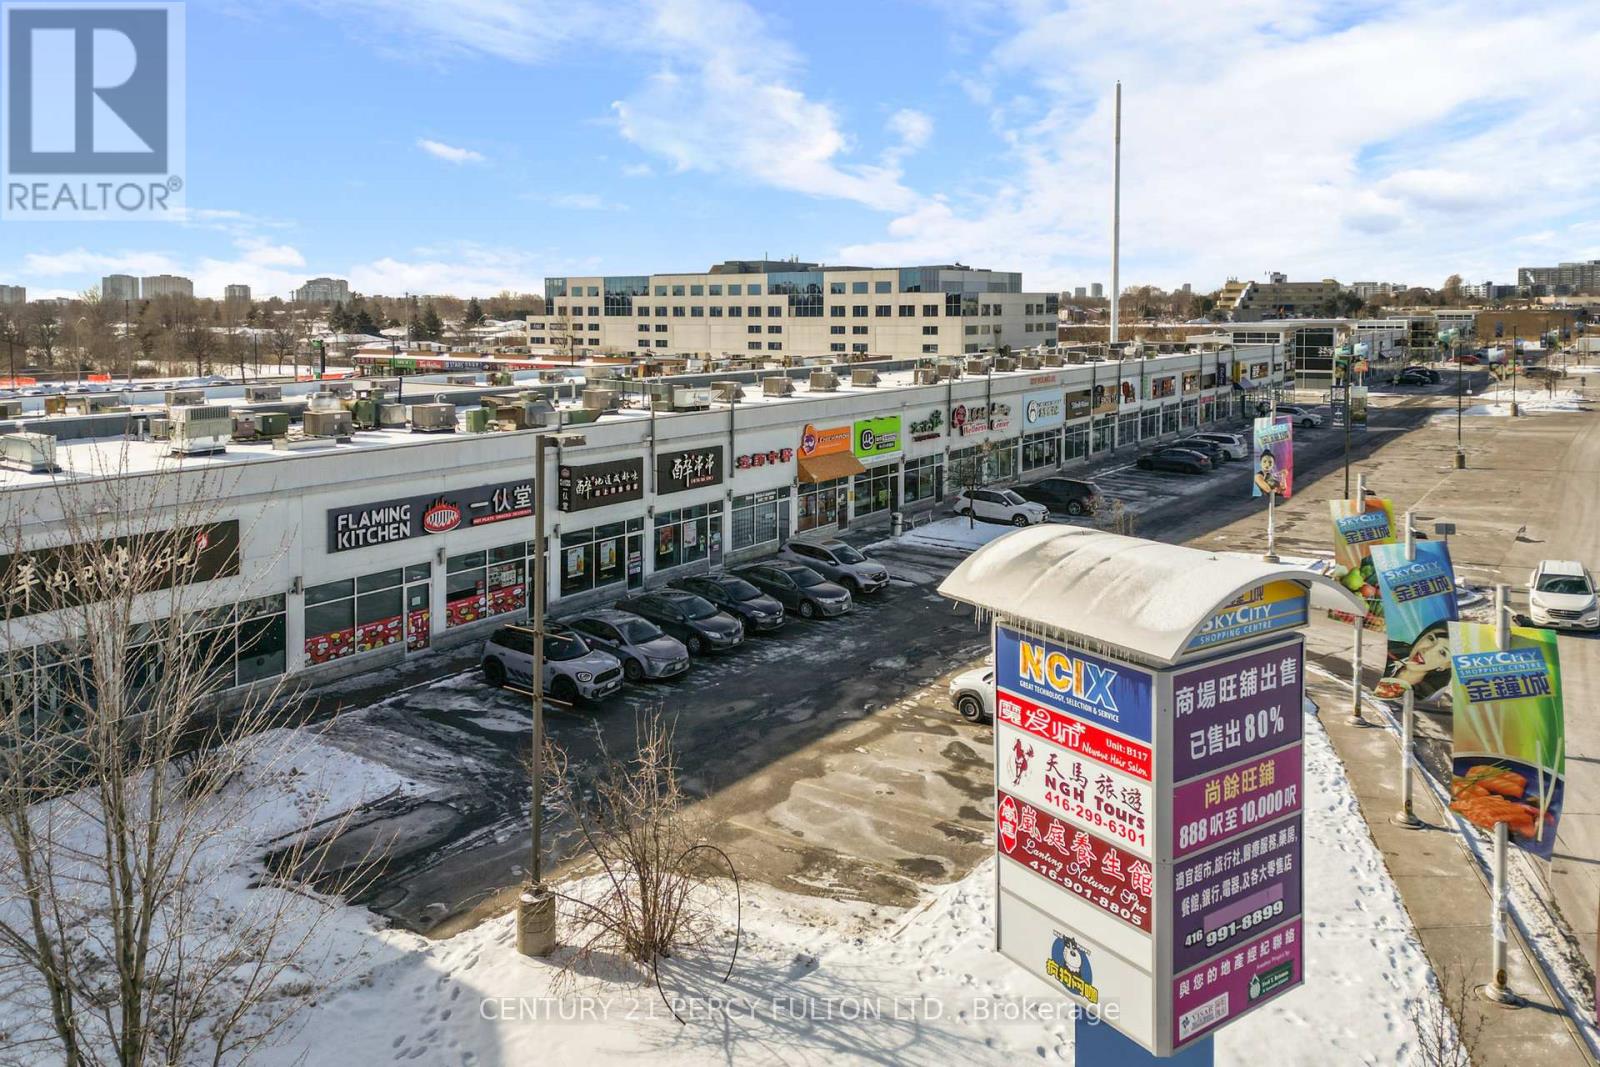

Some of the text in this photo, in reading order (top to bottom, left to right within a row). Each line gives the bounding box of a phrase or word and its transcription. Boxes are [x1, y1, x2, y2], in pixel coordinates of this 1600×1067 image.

[338, 504, 411, 532] FLAMING
[338, 521, 411, 550] KITCHEN
[1200, 621, 1273, 645] SHOPPING CENTRE
[1020, 640, 1119, 712] NCIX
[1175, 657, 1297, 719] 商場旺舖出售
[1460, 662, 1543, 677] SHOPPING CENTRE
[1019, 680, 1034, 691] GREAT
[1066, 697, 1093, 713] SELECTION
[1093, 707, 1098, 715] &
[1098, 709, 1119, 723] SERVICE
[1106, 738, 1148, 761] Unit: B117
[1110, 754, 1127, 768] Hair
[1044, 775, 1145, 831] NGH Tours
[1046, 753, 1144, 815] 天馬旅遊
[1044, 791, 1145, 847] 416-299-6301
[1022, 839, 1148, 914] Lanting Natural Spa
[1028, 860, 1143, 926] 416-901-8805
[1185, 900, 1284, 947] 416 991-8899
